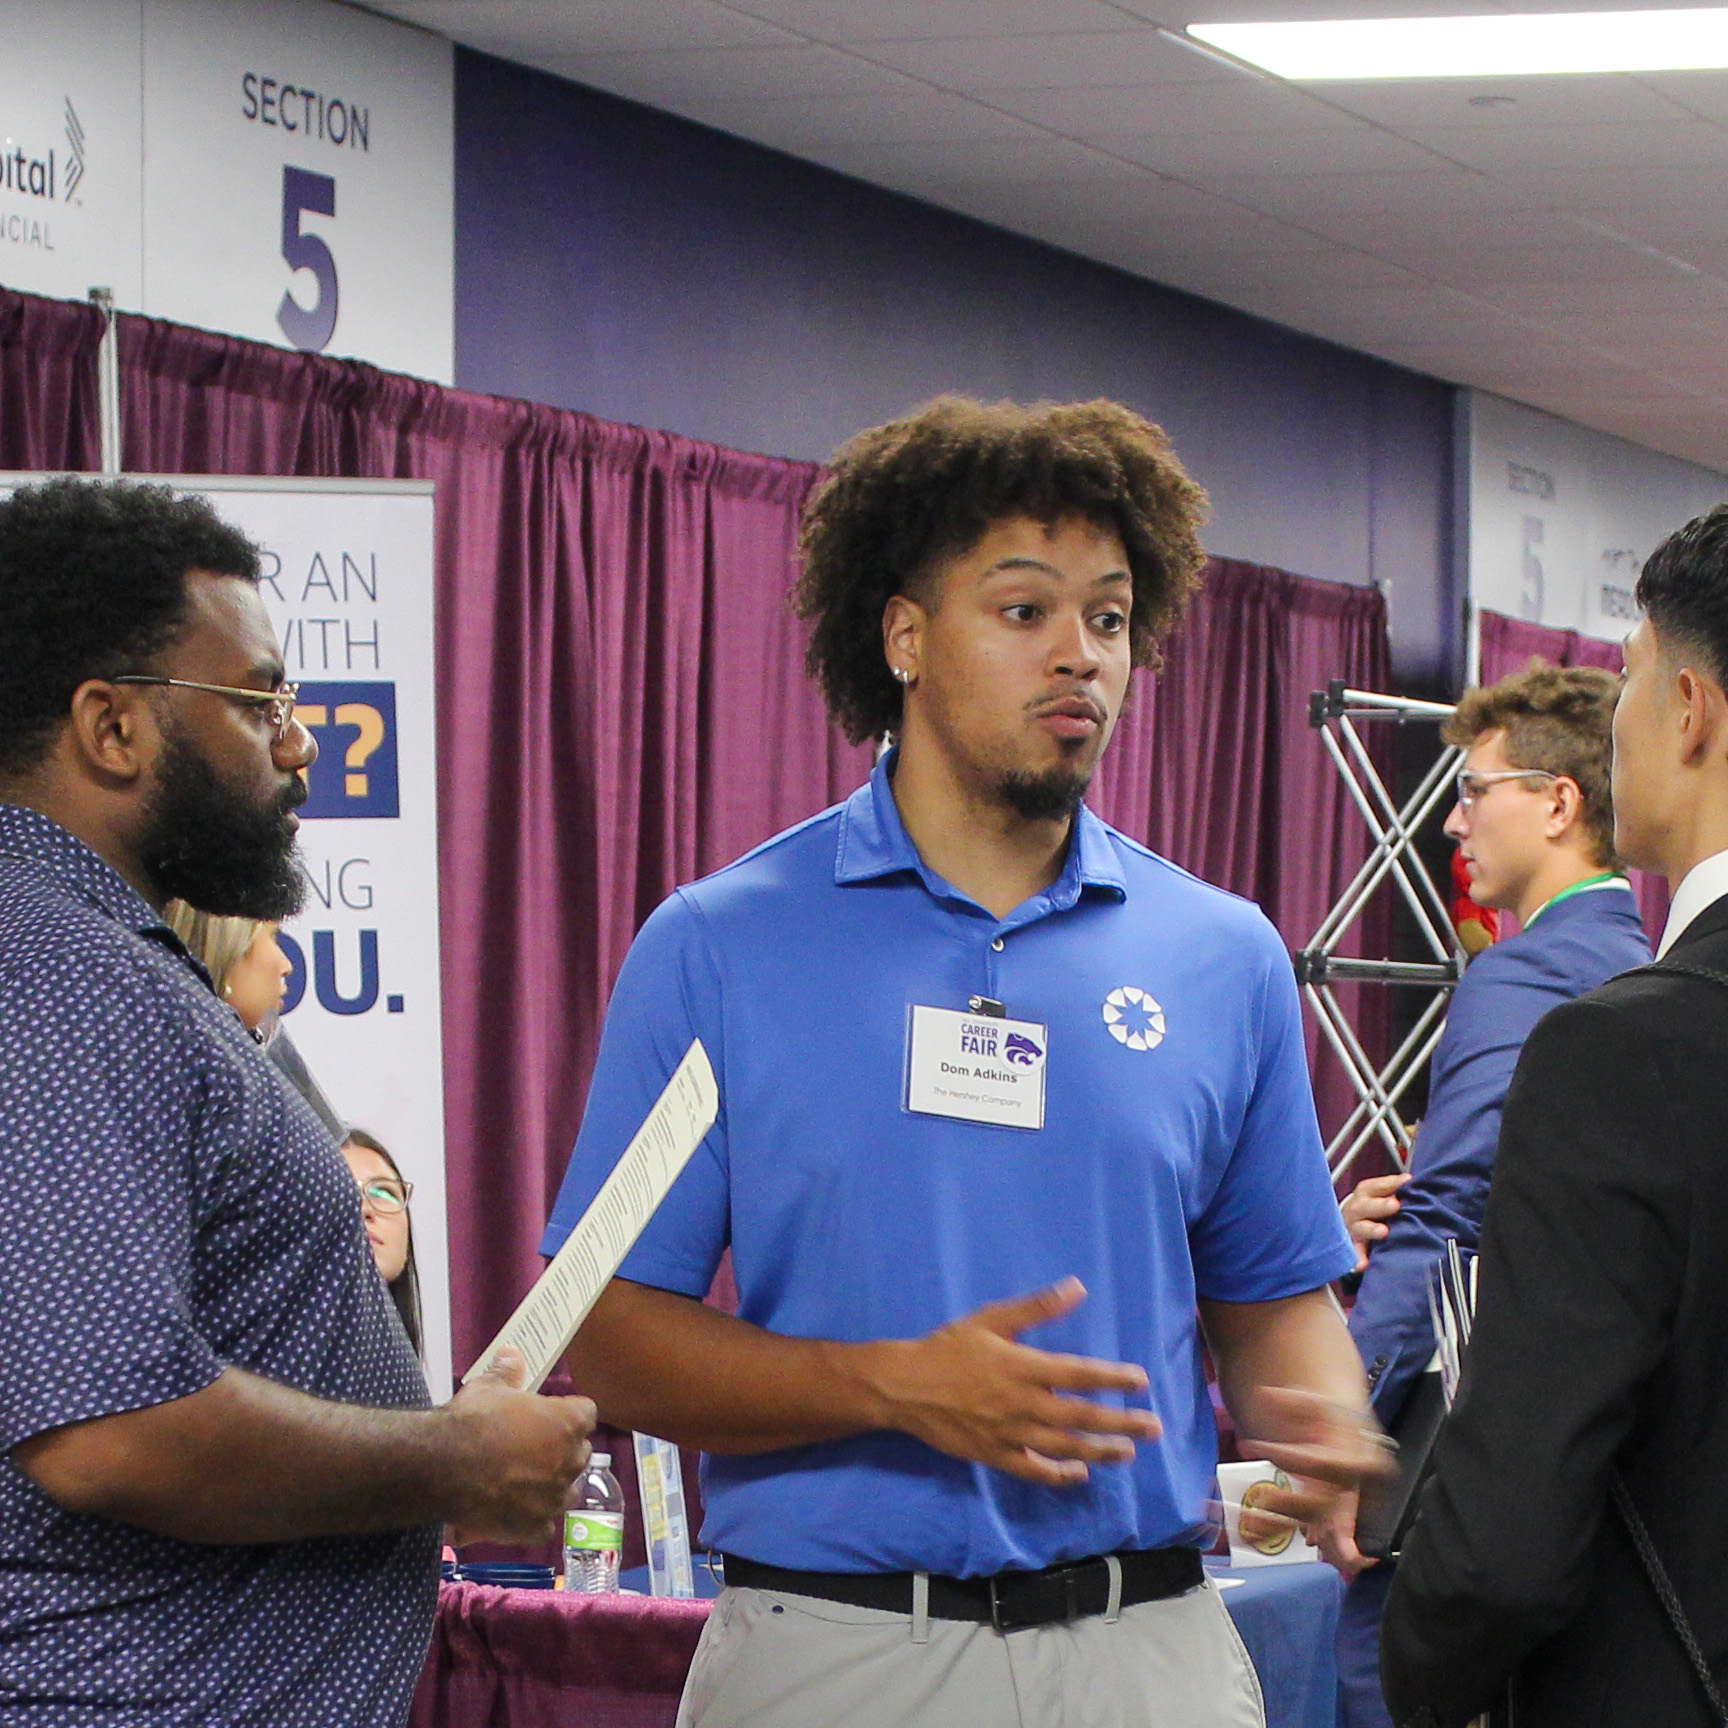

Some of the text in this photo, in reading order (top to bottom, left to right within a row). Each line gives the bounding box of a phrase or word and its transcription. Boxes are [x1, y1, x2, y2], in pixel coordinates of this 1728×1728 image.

[242, 73, 370, 152] SECTION
[277, 164, 340, 353] 5
[301, 551, 377, 602] AN
[283, 618, 379, 670] ITH
[961, 1023, 999, 1039] CAREER
[961, 1036, 998, 1057] FAIR
[940, 1061, 1018, 1084] Dom Adkins
